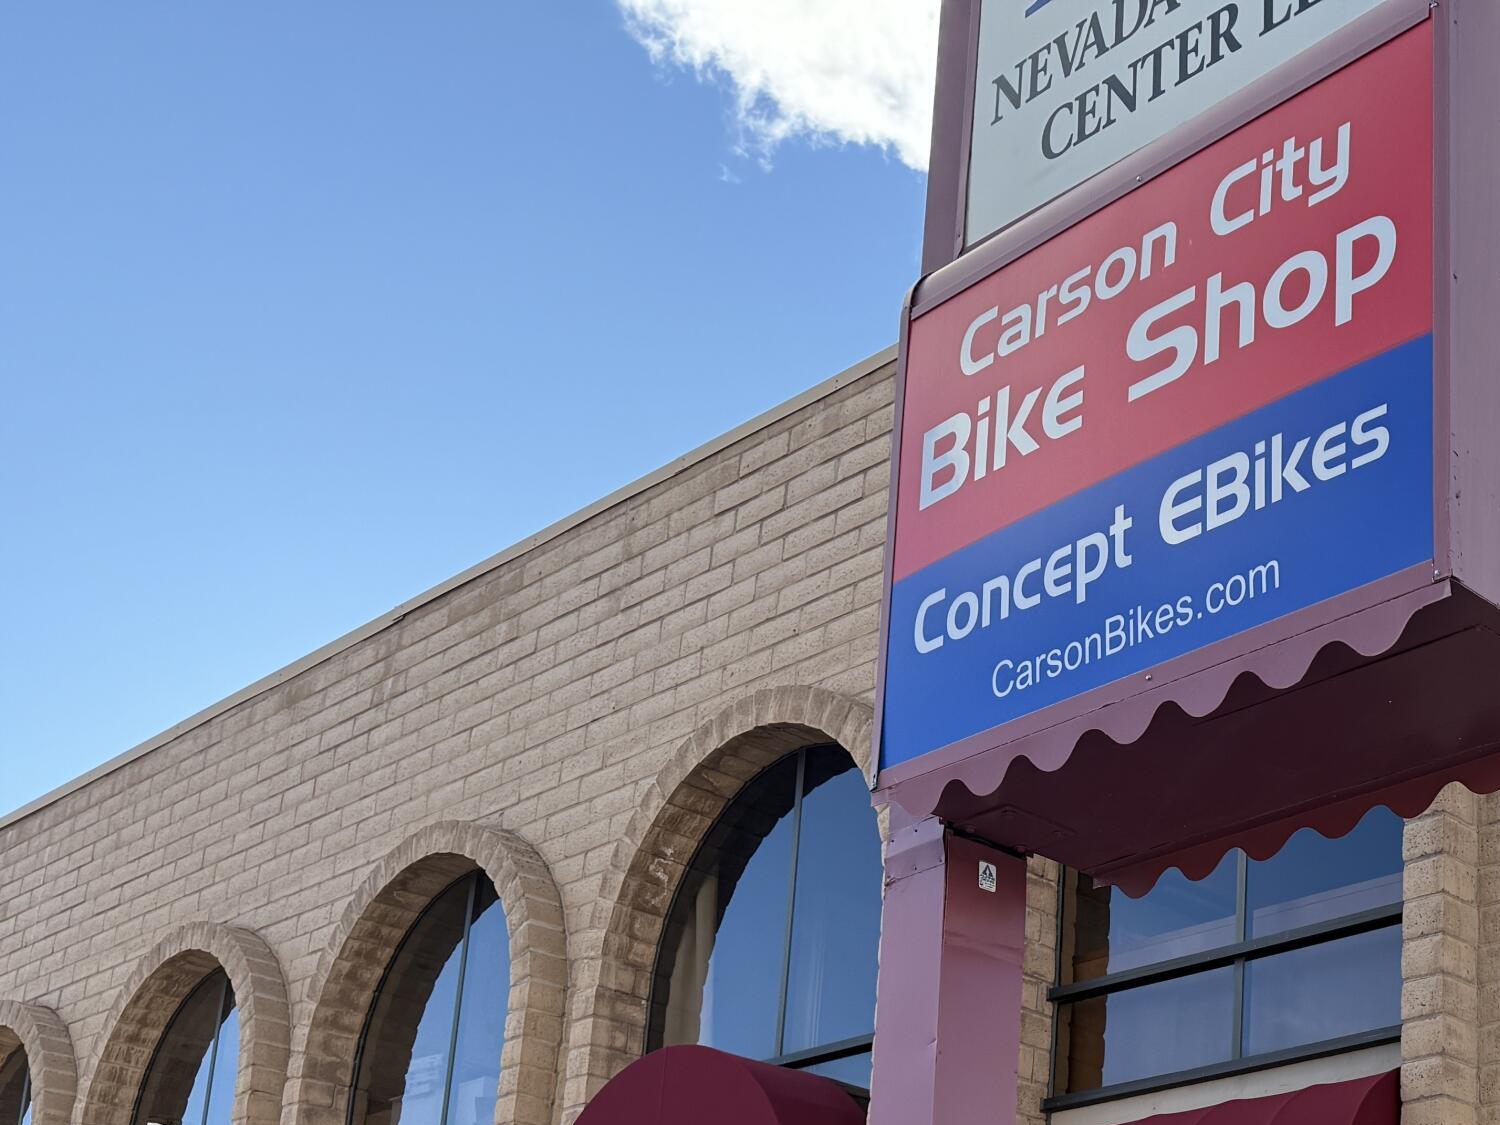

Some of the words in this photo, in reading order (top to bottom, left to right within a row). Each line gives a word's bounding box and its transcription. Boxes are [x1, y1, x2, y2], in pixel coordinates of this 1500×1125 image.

[1041, 2, 1242, 160] CENTER
[919, 364, 1085, 511] Bike
[1126, 215, 1397, 402] Shop
[959, 221, 1177, 376] Carson
[1210, 121, 1351, 236] City
[913, 504, 1133, 654] Concept
[1159, 403, 1390, 545] EBikes
[991, 559, 1281, 697] CarsonBikes.com
